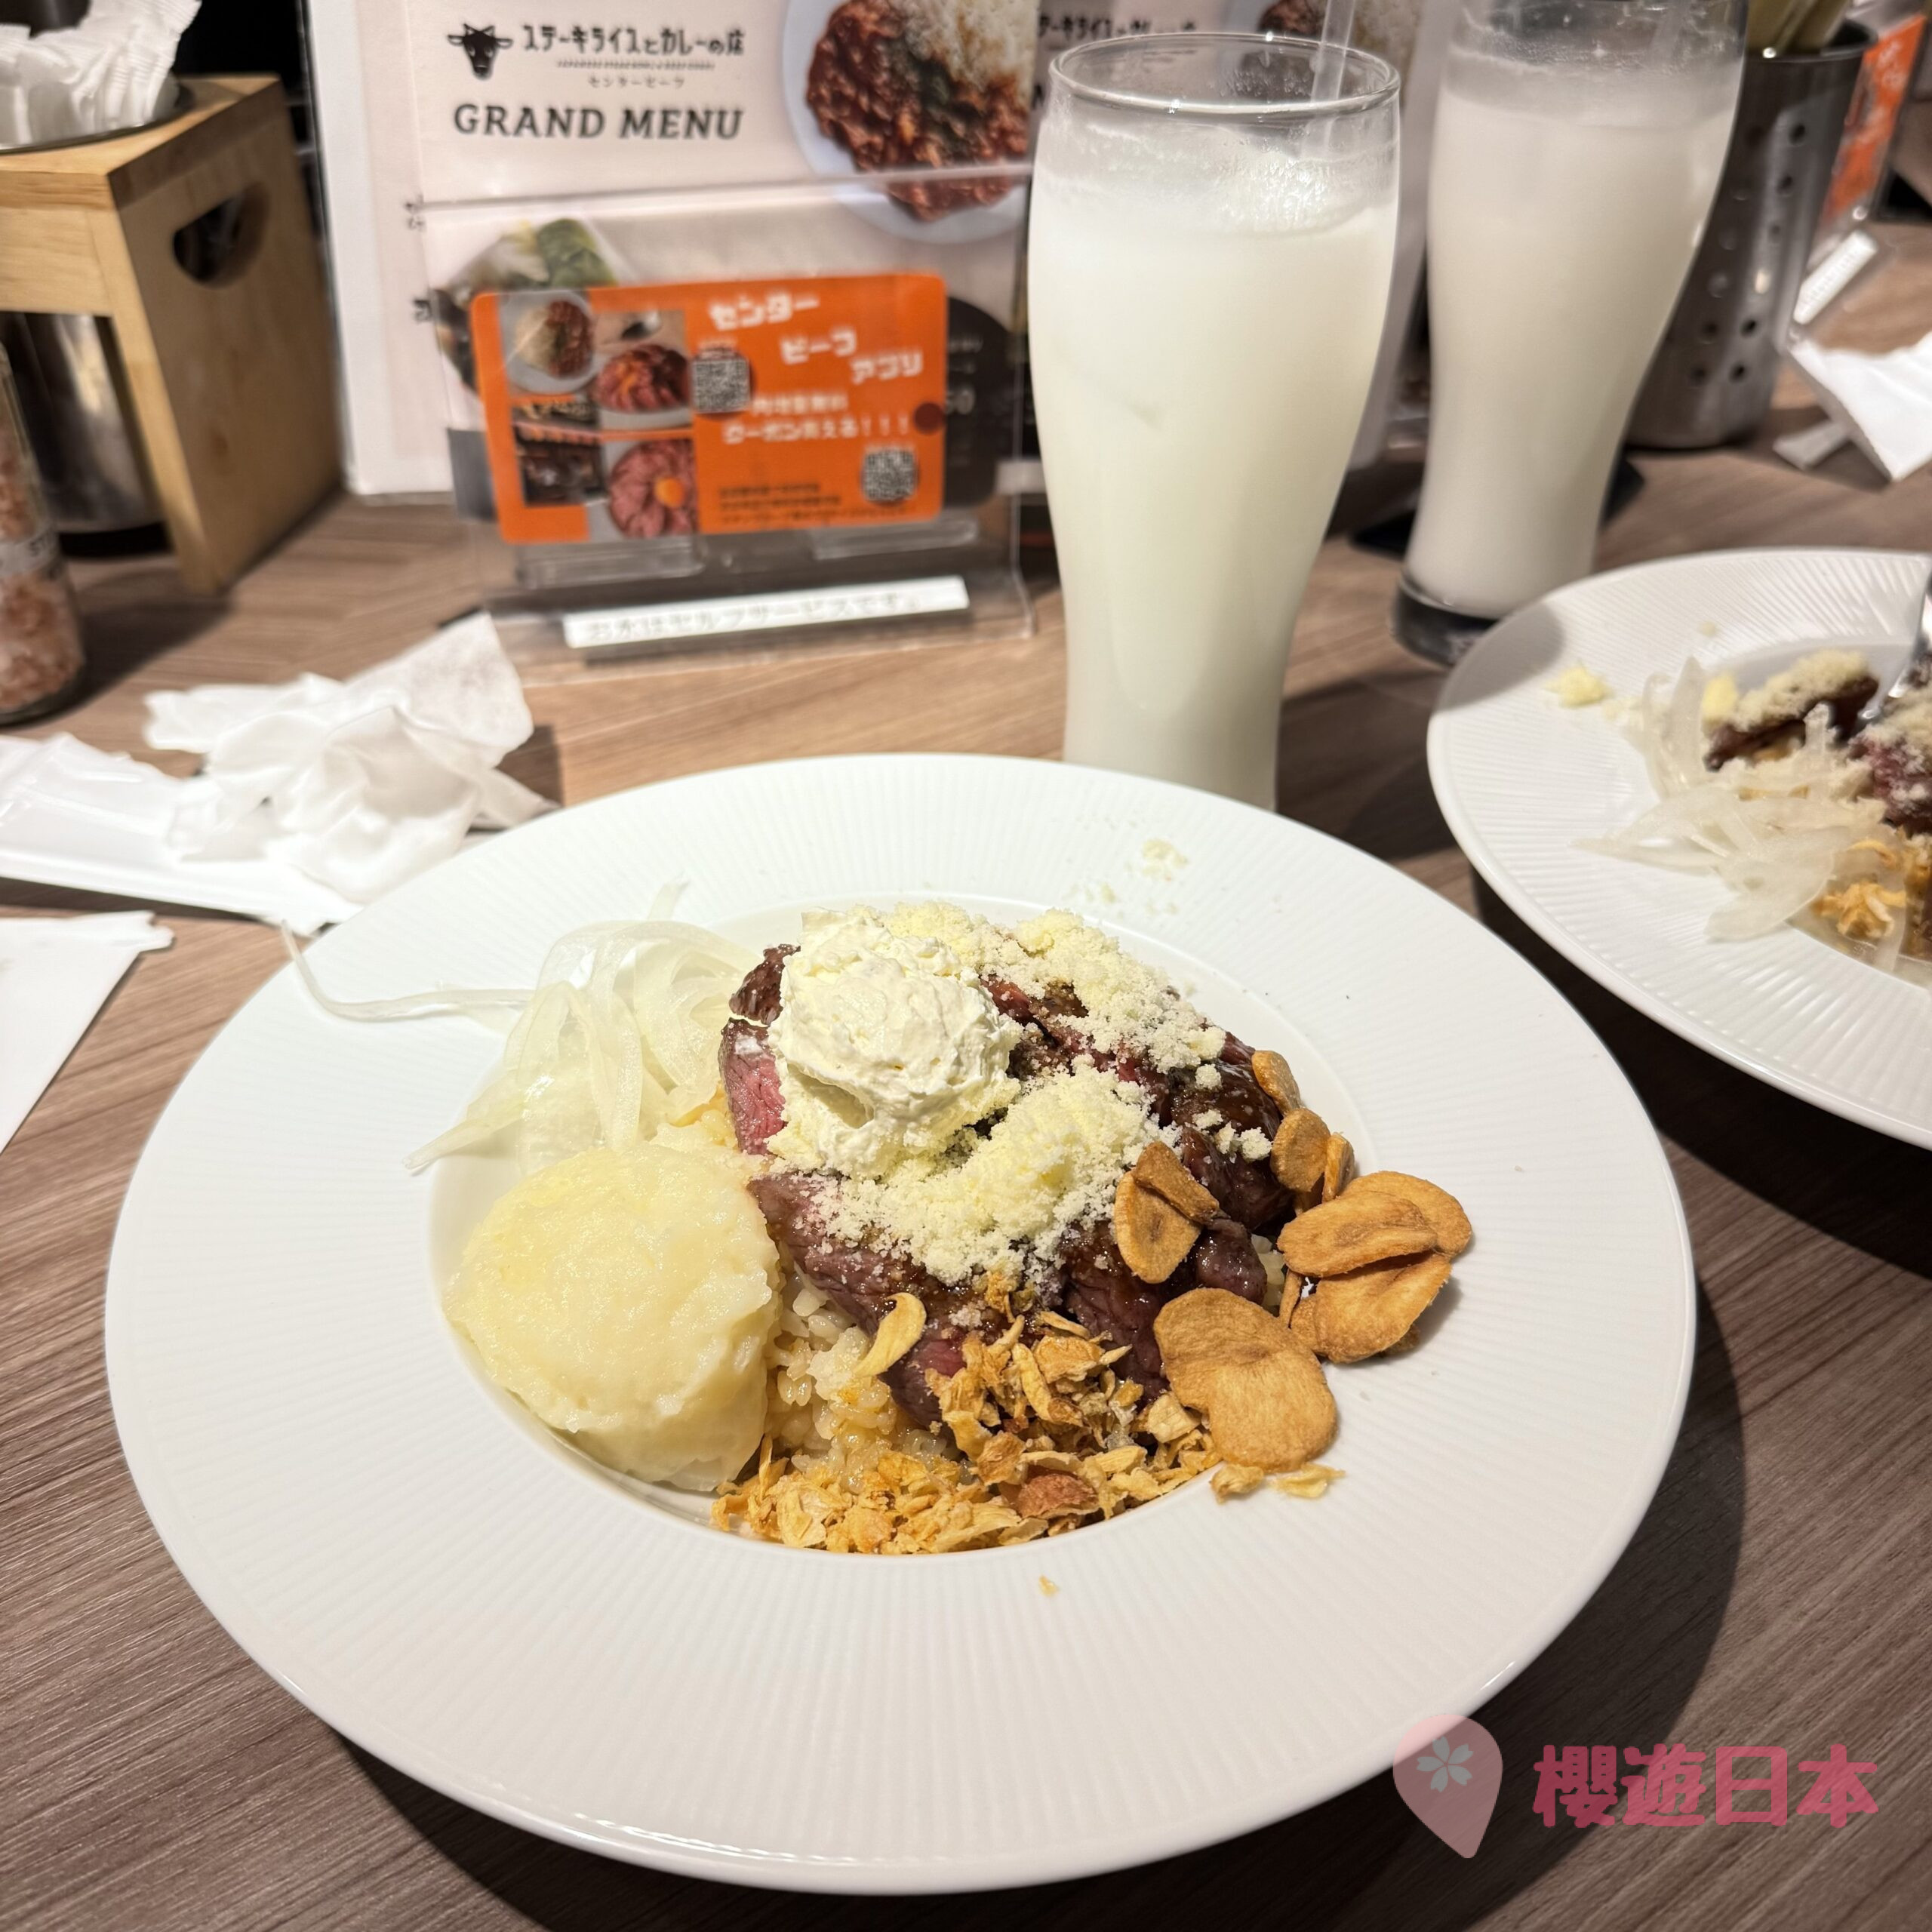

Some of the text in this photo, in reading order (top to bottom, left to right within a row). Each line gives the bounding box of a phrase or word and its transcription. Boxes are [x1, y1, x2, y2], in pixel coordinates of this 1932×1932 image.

[454, 103, 744, 140] GRAND MENU
[708, 290, 820, 331] センター
[780, 325, 857, 365] ビーフ
